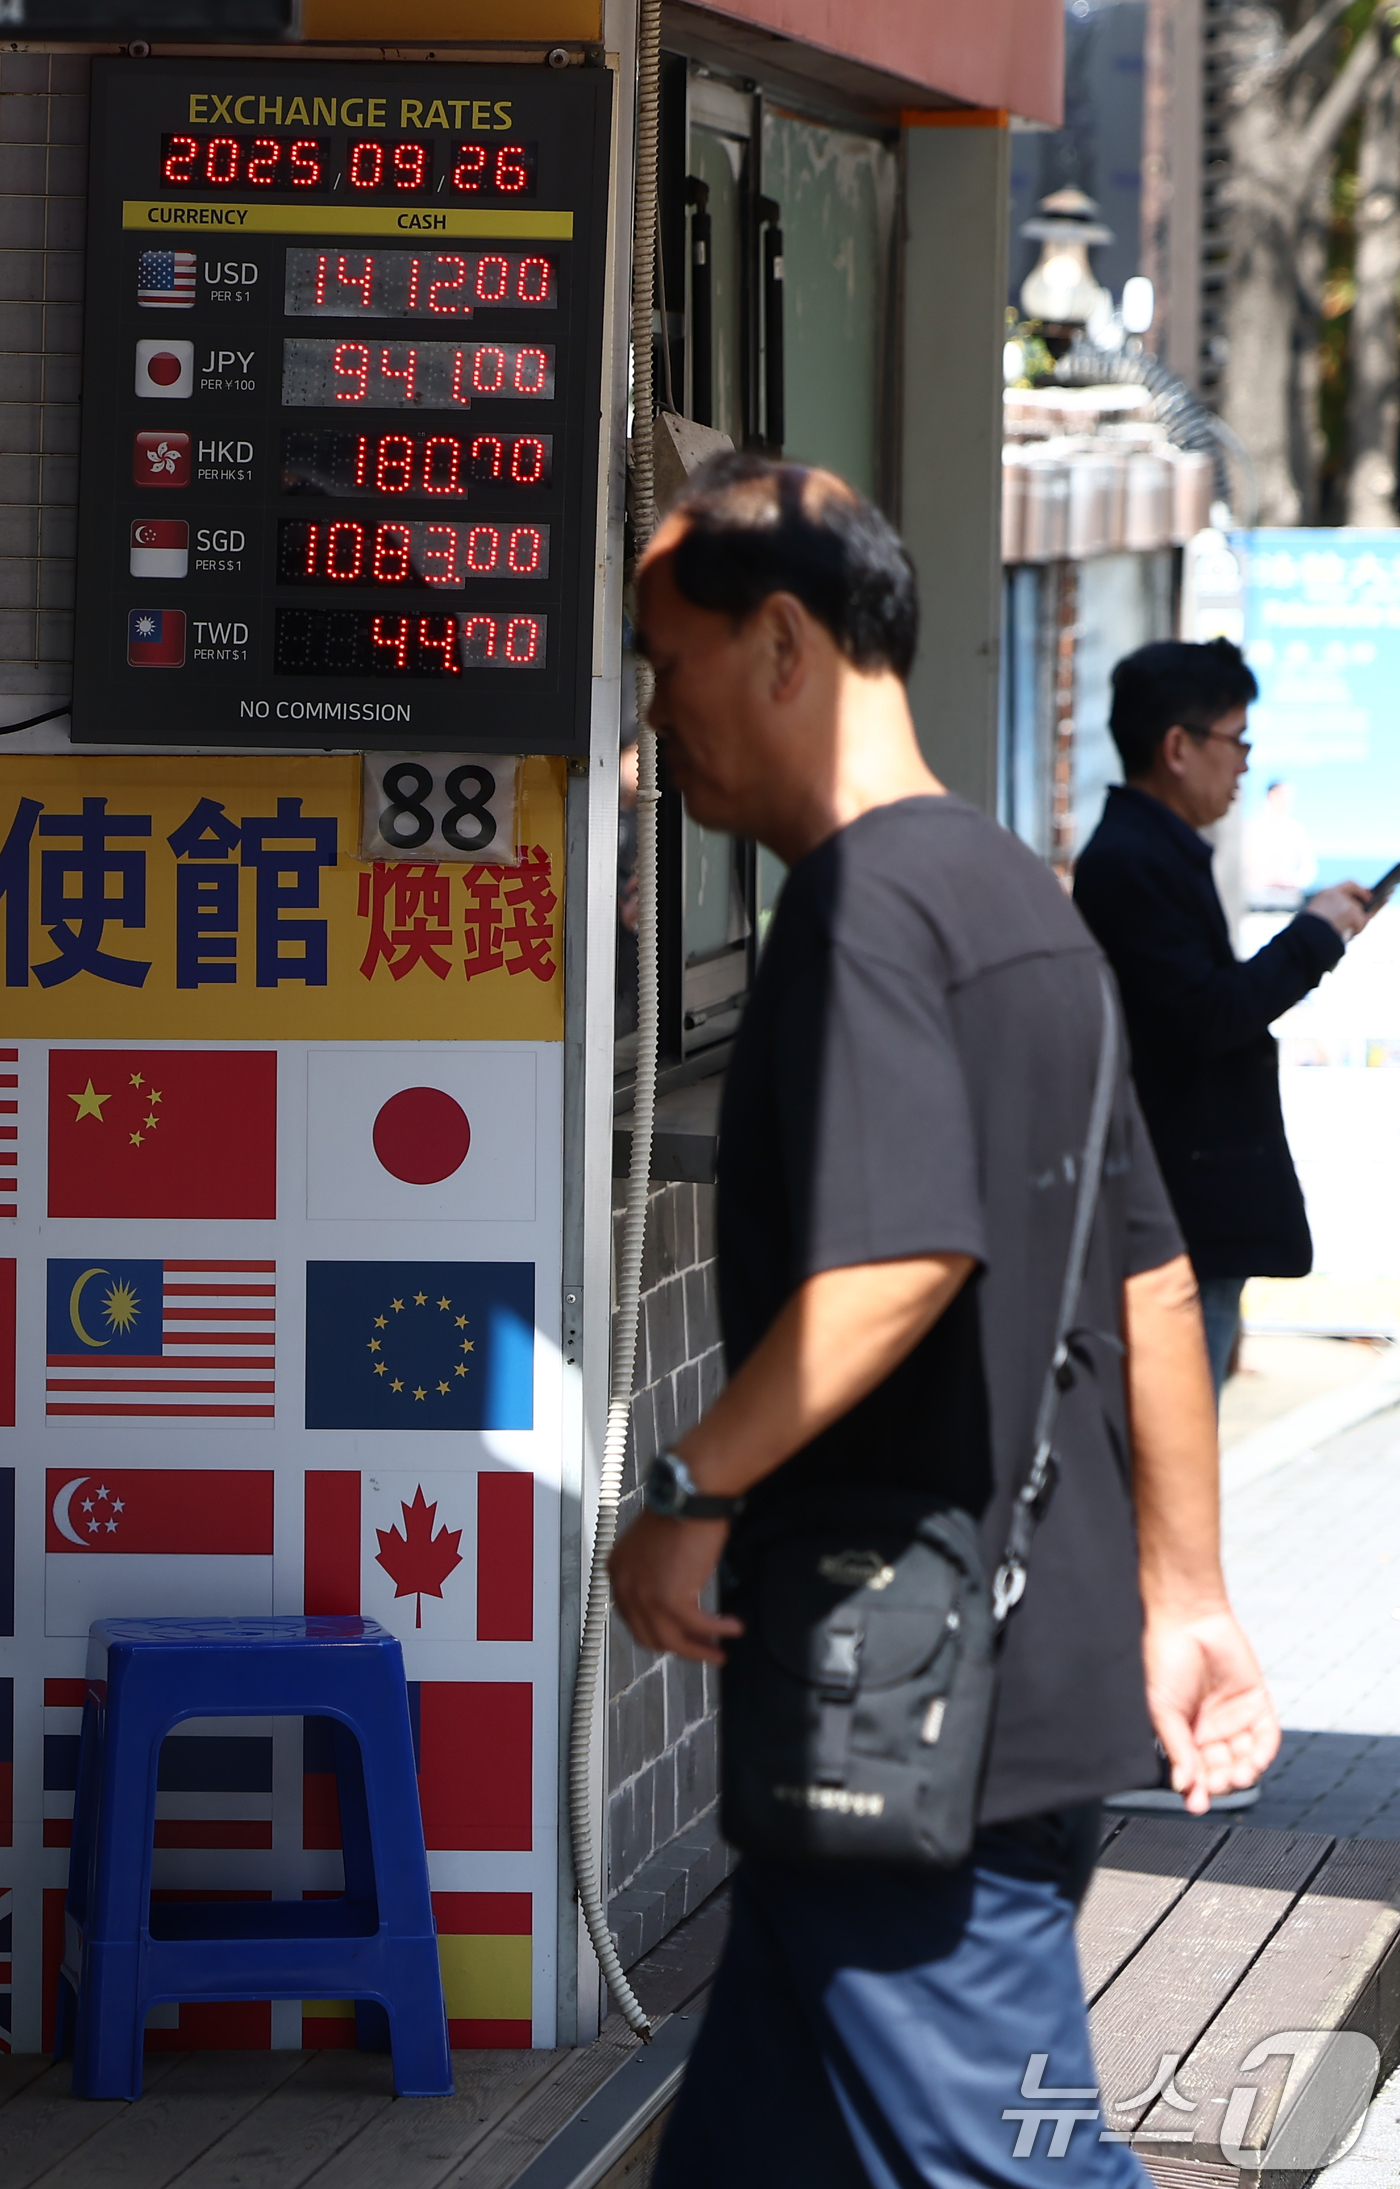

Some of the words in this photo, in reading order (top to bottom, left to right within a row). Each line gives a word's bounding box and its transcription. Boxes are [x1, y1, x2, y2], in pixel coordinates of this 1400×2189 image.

[188, 94, 387, 128] EXCHANGE
[400, 99, 513, 131] RATES
[147, 207, 249, 227] CURRENCY
[397, 213, 447, 231] CASH
[204, 261, 259, 285] USD
[314, 255, 552, 314] 1412.00
[210, 290, 232, 302] PER
[202, 350, 256, 374] JPY
[332, 342, 548, 404] 941.00
[200, 379, 223, 390] PER
[198, 440, 254, 463] HKD
[197, 468, 219, 480] PER
[354, 434, 545, 495] 180.70
[196, 529, 246, 552] SGD
[305, 521, 542, 584] 1083.00
[195, 559, 217, 571] PER
[192, 621, 249, 645] TWD
[372, 616, 540, 673] 44.70
[193, 648, 215, 660] PER
[239, 700, 270, 719] NO
[275, 701, 412, 723] COMMISSION
[378, 761, 497, 852] 88
[0, 796, 338, 990] 使館
